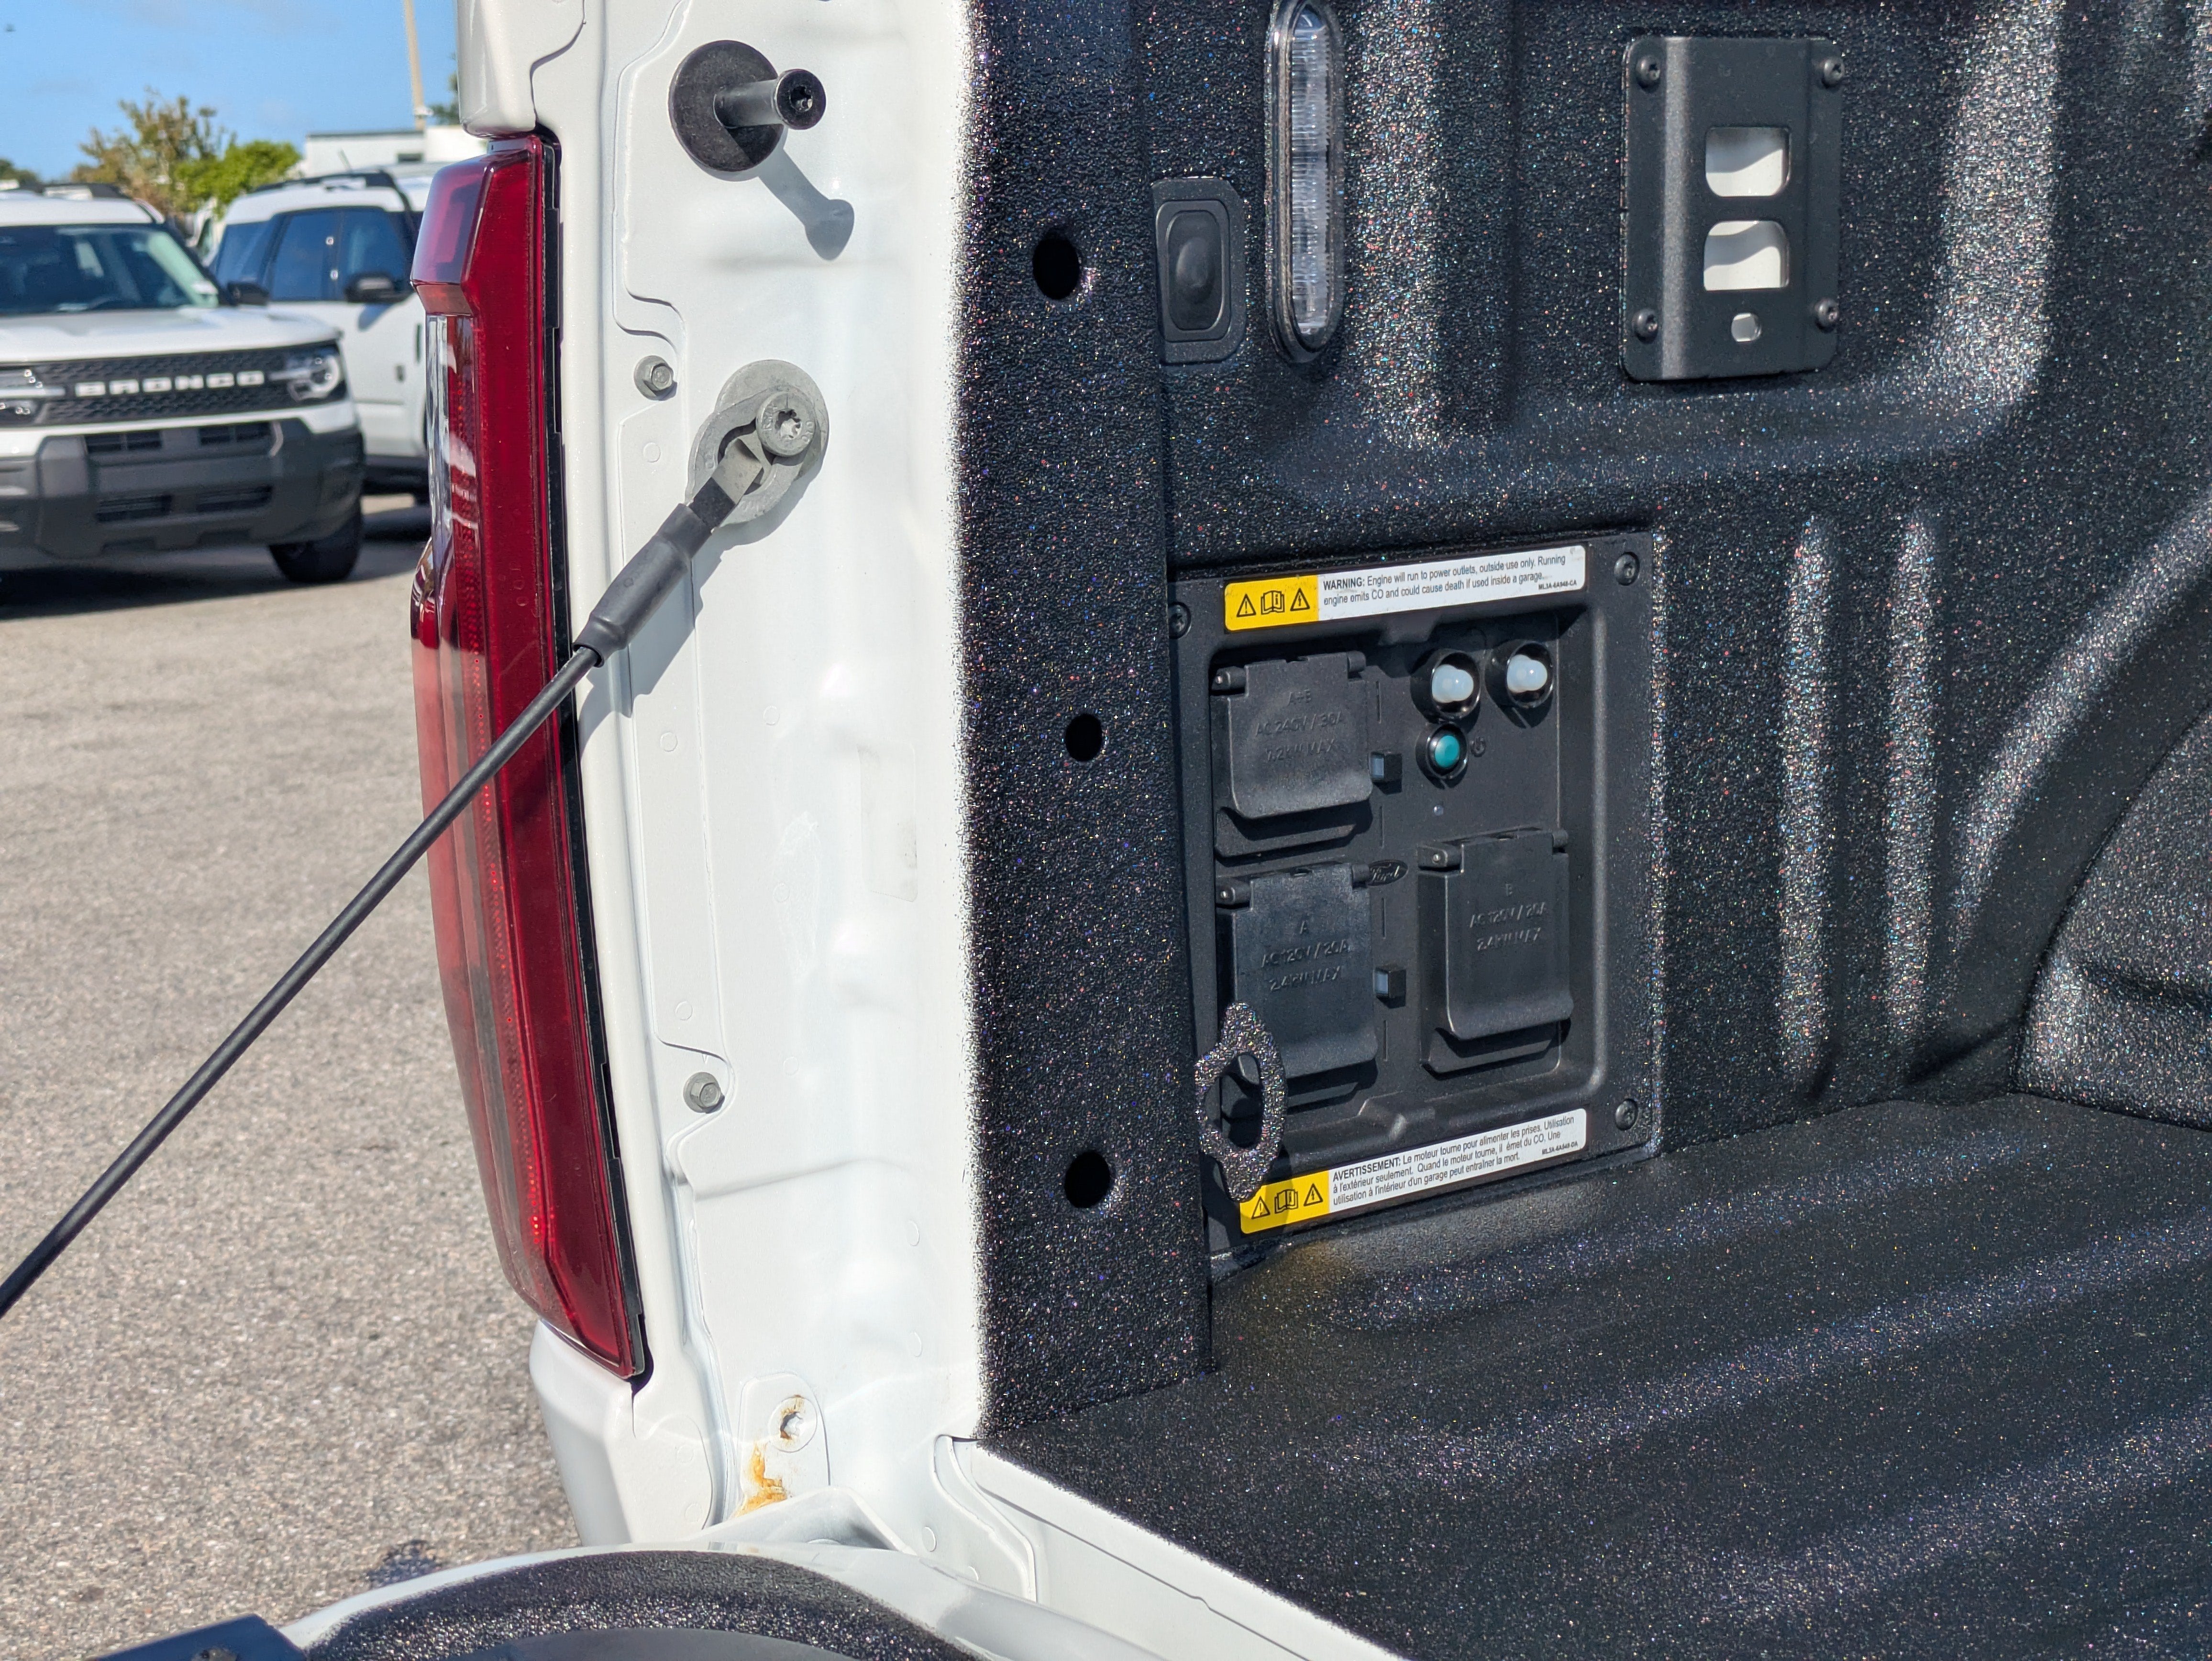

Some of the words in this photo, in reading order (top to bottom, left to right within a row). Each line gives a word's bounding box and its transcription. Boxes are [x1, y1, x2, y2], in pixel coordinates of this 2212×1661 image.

[75, 371, 265, 397] BRONCO
[1323, 577, 1365, 590] WARNING:
[1367, 576, 1392, 587] Engine
[1394, 572, 1405, 583] will
[1407, 573, 1418, 581] run
[1421, 570, 1427, 580] to
[1429, 569, 1450, 581] power
[1452, 564, 1478, 576] outlets,
[1480, 561, 1504, 573] outside
[1506, 562, 1518, 570] use
[1521, 557, 1536, 569] only.
[1538, 554, 1566, 566] Running
[1324, 595, 1348, 607] engine
[1350, 591, 1369, 602] emits
[1371, 589, 1383, 599] CO
[1386, 587, 1399, 598] and
[1401, 585, 1420, 596] could
[1422, 584, 1443, 594] cause
[1445, 578, 1464, 591] death
[1466, 578, 1471, 589] if
[1472, 576, 1489, 587] used
[1491, 574, 1510, 586] inside
[1513, 575, 1517, 583] a
[1519, 572, 1545, 585] garage.
[1370, 863, 1401, 881] Ford
[1299, 921, 1310, 934] A
[1333, 1157, 1401, 1182] AVERTISSEMENT:
[1403, 1155, 1412, 1164] Le
[1414, 1149, 1438, 1162] moteur
[1440, 1144, 1461, 1156] tourne
[1463, 1140, 1478, 1152] pour
[1480, 1132, 1508, 1146] alimenter
[1511, 1129, 1520, 1138] les
[1522, 1124, 1542, 1137] prises.
[1544, 1116, 1574, 1130] Utilisation
[1333, 1184, 1338, 1194] à
[1340, 1177, 1373, 1193] l'extérieur
[1376, 1167, 1413, 1183] seulement.
[1417, 1158, 1440, 1172] Quand
[1443, 1158, 1449, 1166] le
[1450, 1152, 1473, 1164] moteur
[1475, 1147, 1497, 1159] tourne,
[1499, 1143, 1503, 1153] il
[1506, 1140, 1522, 1151] émet
[1524, 1137, 1531, 1146] du
[1533, 1133, 1546, 1144] CO.
[1548, 1130, 1560, 1141] Une
[1334, 1190, 1366, 1206] utilisation
[1369, 1186, 1373, 1196] à
[1375, 1181, 1406, 1196] l'intérieur
[1408, 1177, 1422, 1187] d'un
[1424, 1171, 1448, 1185] garage
[1450, 1165, 1464, 1178] peut
[1466, 1158, 1495, 1173] entraîner
[1496, 1156, 1502, 1165] la
[1504, 1152, 1519, 1163] mort.
